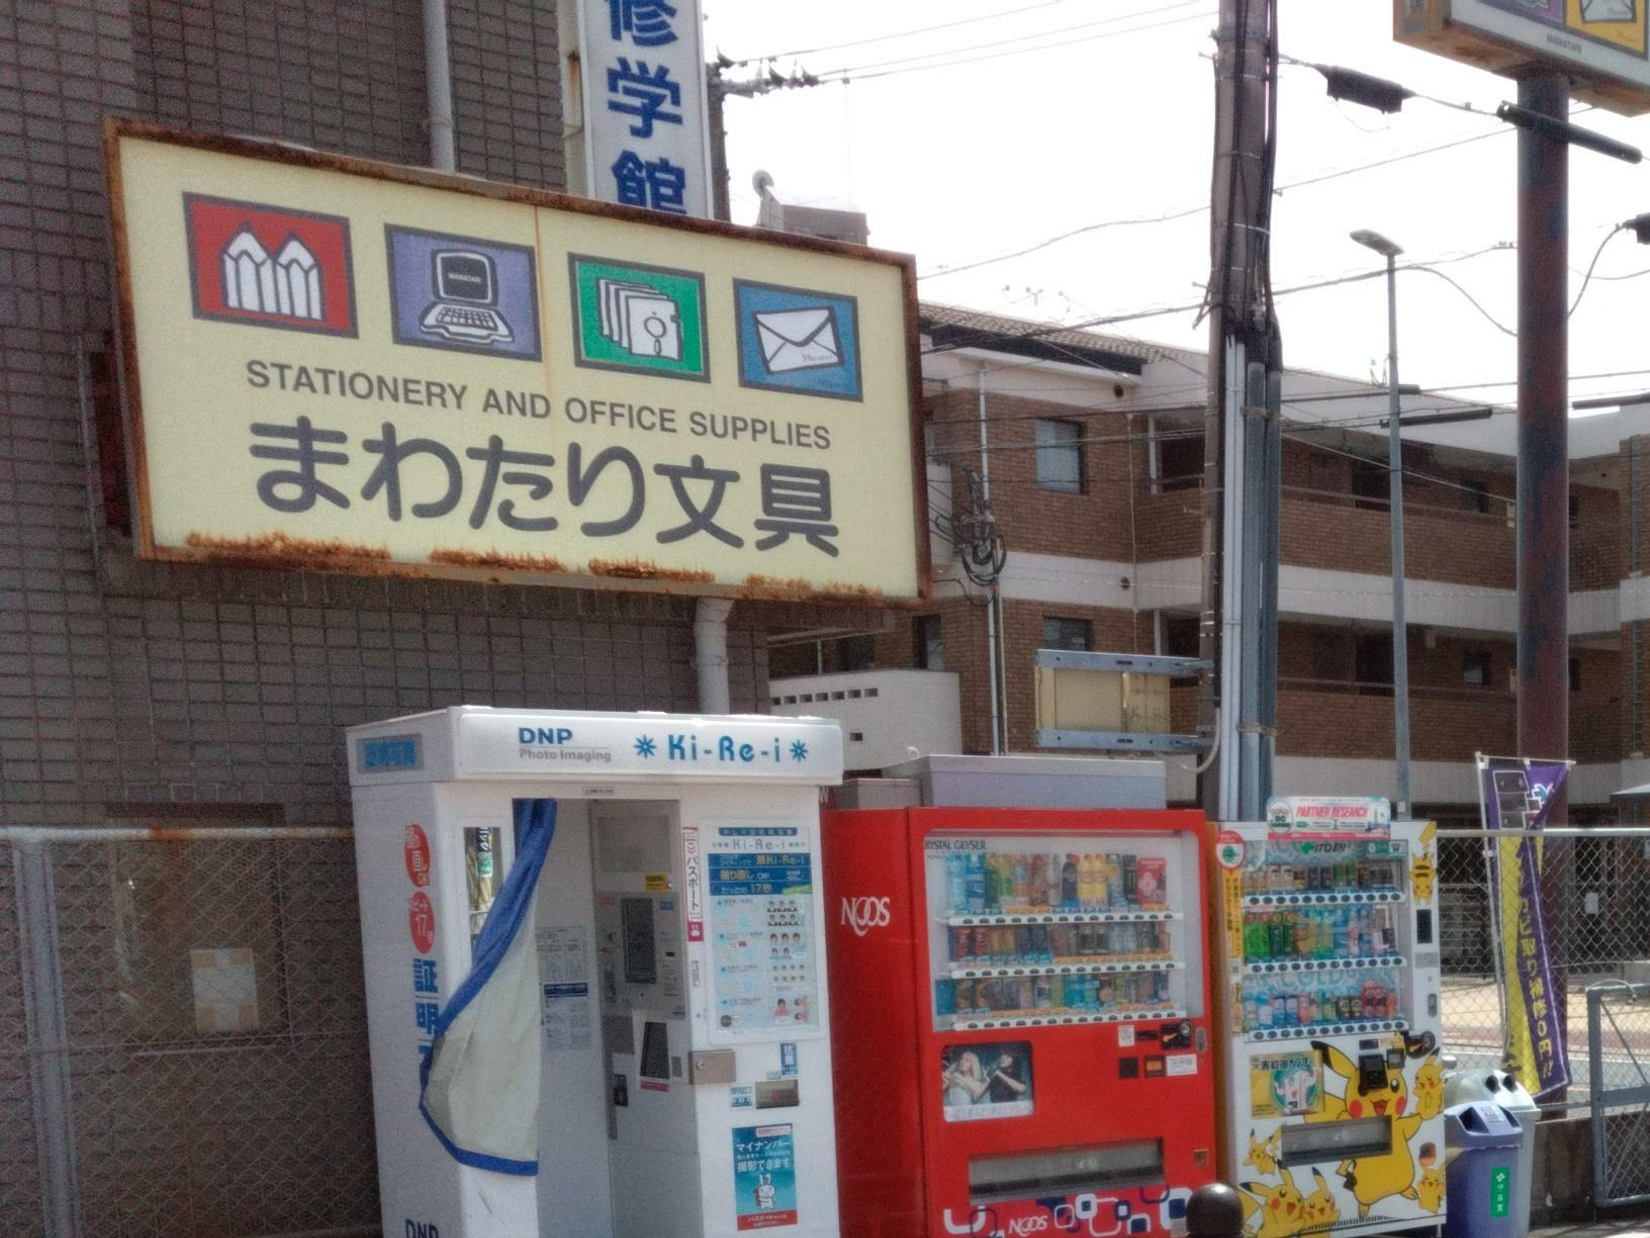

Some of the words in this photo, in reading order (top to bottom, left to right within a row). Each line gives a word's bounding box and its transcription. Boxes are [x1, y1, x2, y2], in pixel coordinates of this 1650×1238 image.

[246, 359, 469, 412] STATIONERY
[482, 387, 553, 422] AND
[565, 396, 679, 436] OFFICE
[689, 410, 832, 452] SUPPLIES
[248, 415, 841, 559] まわたり文具
[518, 727, 574, 744] DNP
[519, 748, 557, 760] Photo
[560, 748, 612, 763] Imaging
[667, 734, 782, 763] Ki-Re-i
[1295, 805, 1331, 819] PARTNER
[1332, 805, 1370, 819] RESEARCH
[732, 838, 786, 850] Ki-Re-i
[954, 839, 986, 851] GEYSER
[841, 895, 891, 937] NOOS
[736, 1139, 791, 1152] マイナンバー
[1008, 1215, 1048, 1237] NOOS
